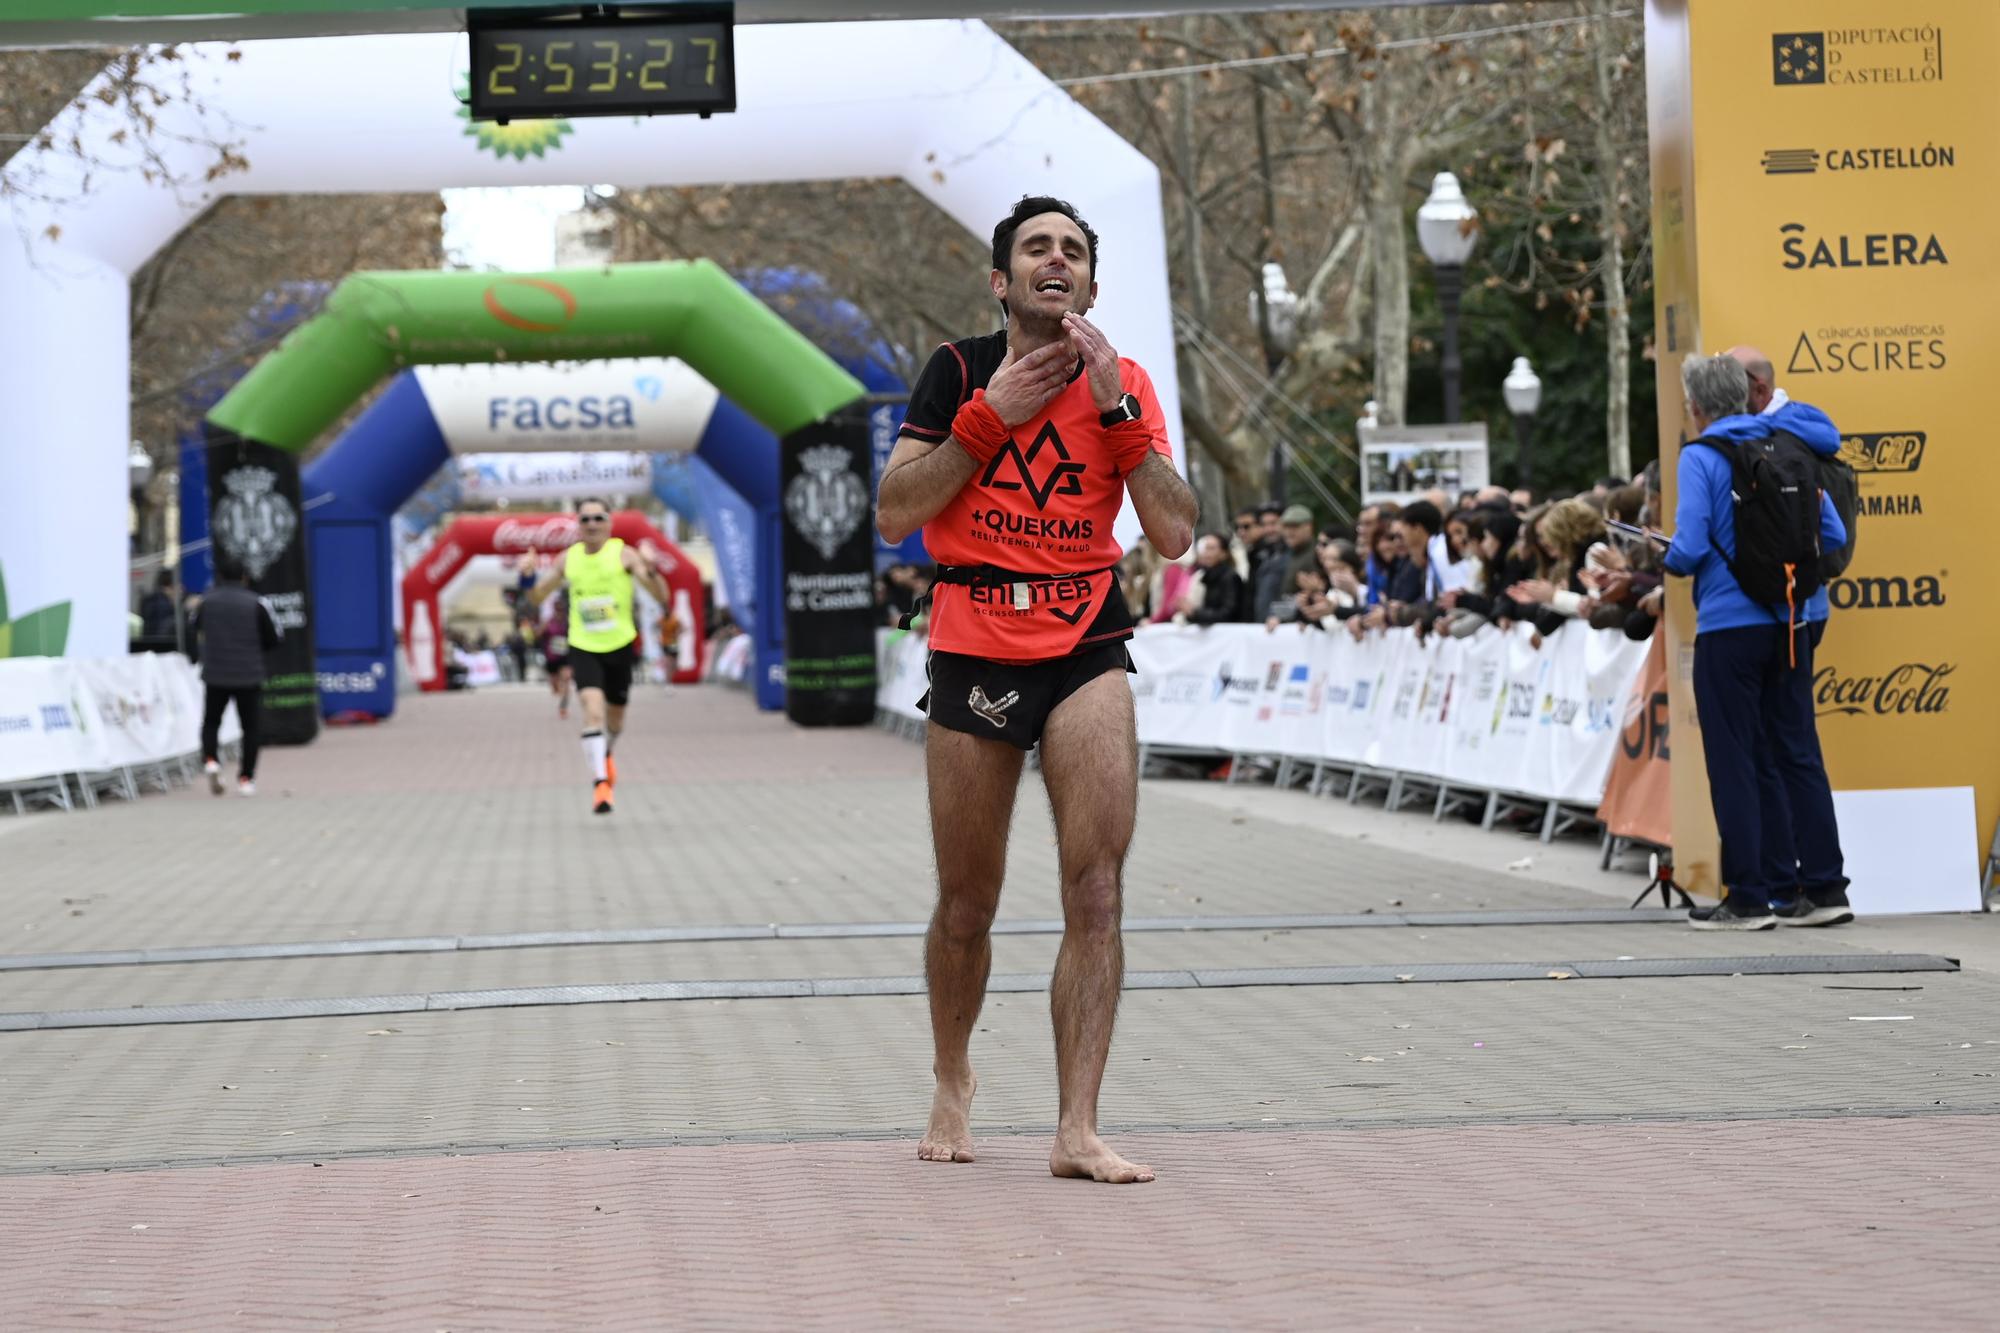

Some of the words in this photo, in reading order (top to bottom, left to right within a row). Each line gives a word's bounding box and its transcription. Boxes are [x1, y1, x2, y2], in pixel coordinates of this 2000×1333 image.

[1827, 23, 1935, 45] DIPUTACIÓ
[488, 37, 717, 94] 2:53:27
[1828, 65, 1936, 85] CASTELLÓ
[1826, 141, 1954, 170] CASTELLÓN
[1780, 223, 1948, 269] SALERA
[1817, 325, 1870, 340] CLÍNICAS
[1874, 322, 1945, 338] BIOMÉDICAS
[1787, 330, 1946, 374] ASCIRES
[1856, 495, 1923, 517] AMAHA
[972, 509, 1093, 539] +QUEKMS
[971, 529, 1042, 550] RESISTENCIA
[1058, 543, 1091, 553] SALUD
[1828, 574, 1946, 609] oma
